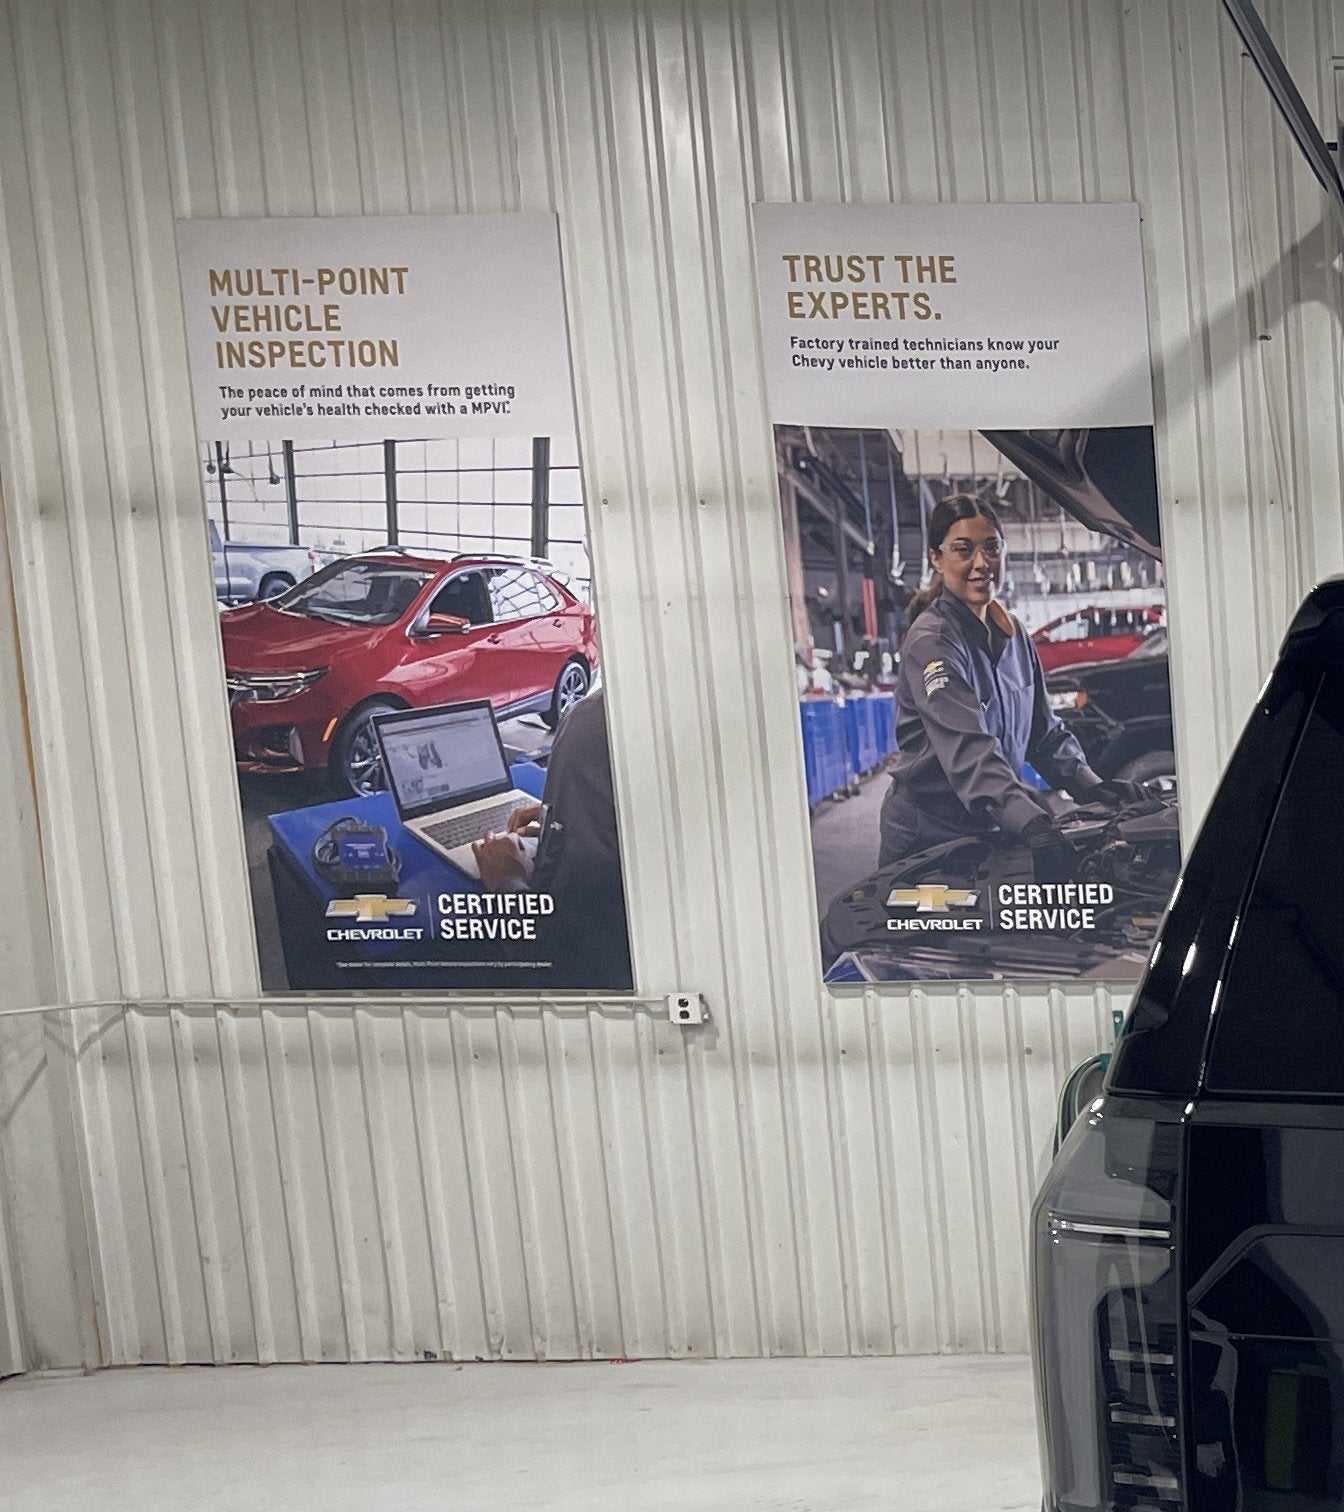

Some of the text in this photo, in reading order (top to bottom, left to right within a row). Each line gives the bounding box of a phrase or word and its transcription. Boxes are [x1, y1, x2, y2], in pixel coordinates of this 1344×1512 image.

[782, 255, 957, 283] TRUST THE
[209, 267, 408, 297] MULTI-POINT
[787, 291, 942, 320] EXPERTS.
[211, 304, 341, 333] VEHICLE
[216, 339, 399, 369] INSPECTION
[790, 336, 1060, 353] Factory trained technicians know your
[792, 354, 1030, 373] Chevy vehicle better than anyone.
[219, 382, 515, 402] The peace of mind that comes from getting
[220, 404, 253, 419] your
[256, 402, 313, 416] vehicle's
[317, 402, 360, 416] health
[364, 401, 421, 415] checked
[425, 401, 456, 415] with
[459, 404, 468, 415] a
[438, 893, 554, 915] CERTIFIED
[998, 883, 1113, 905] CERTIFIED
[440, 918, 537, 940] SERVICE
[887, 918, 983, 930] CHEVROLET
[999, 908, 1096, 930] SERVICE
[326, 928, 424, 941] CHEVROLET
